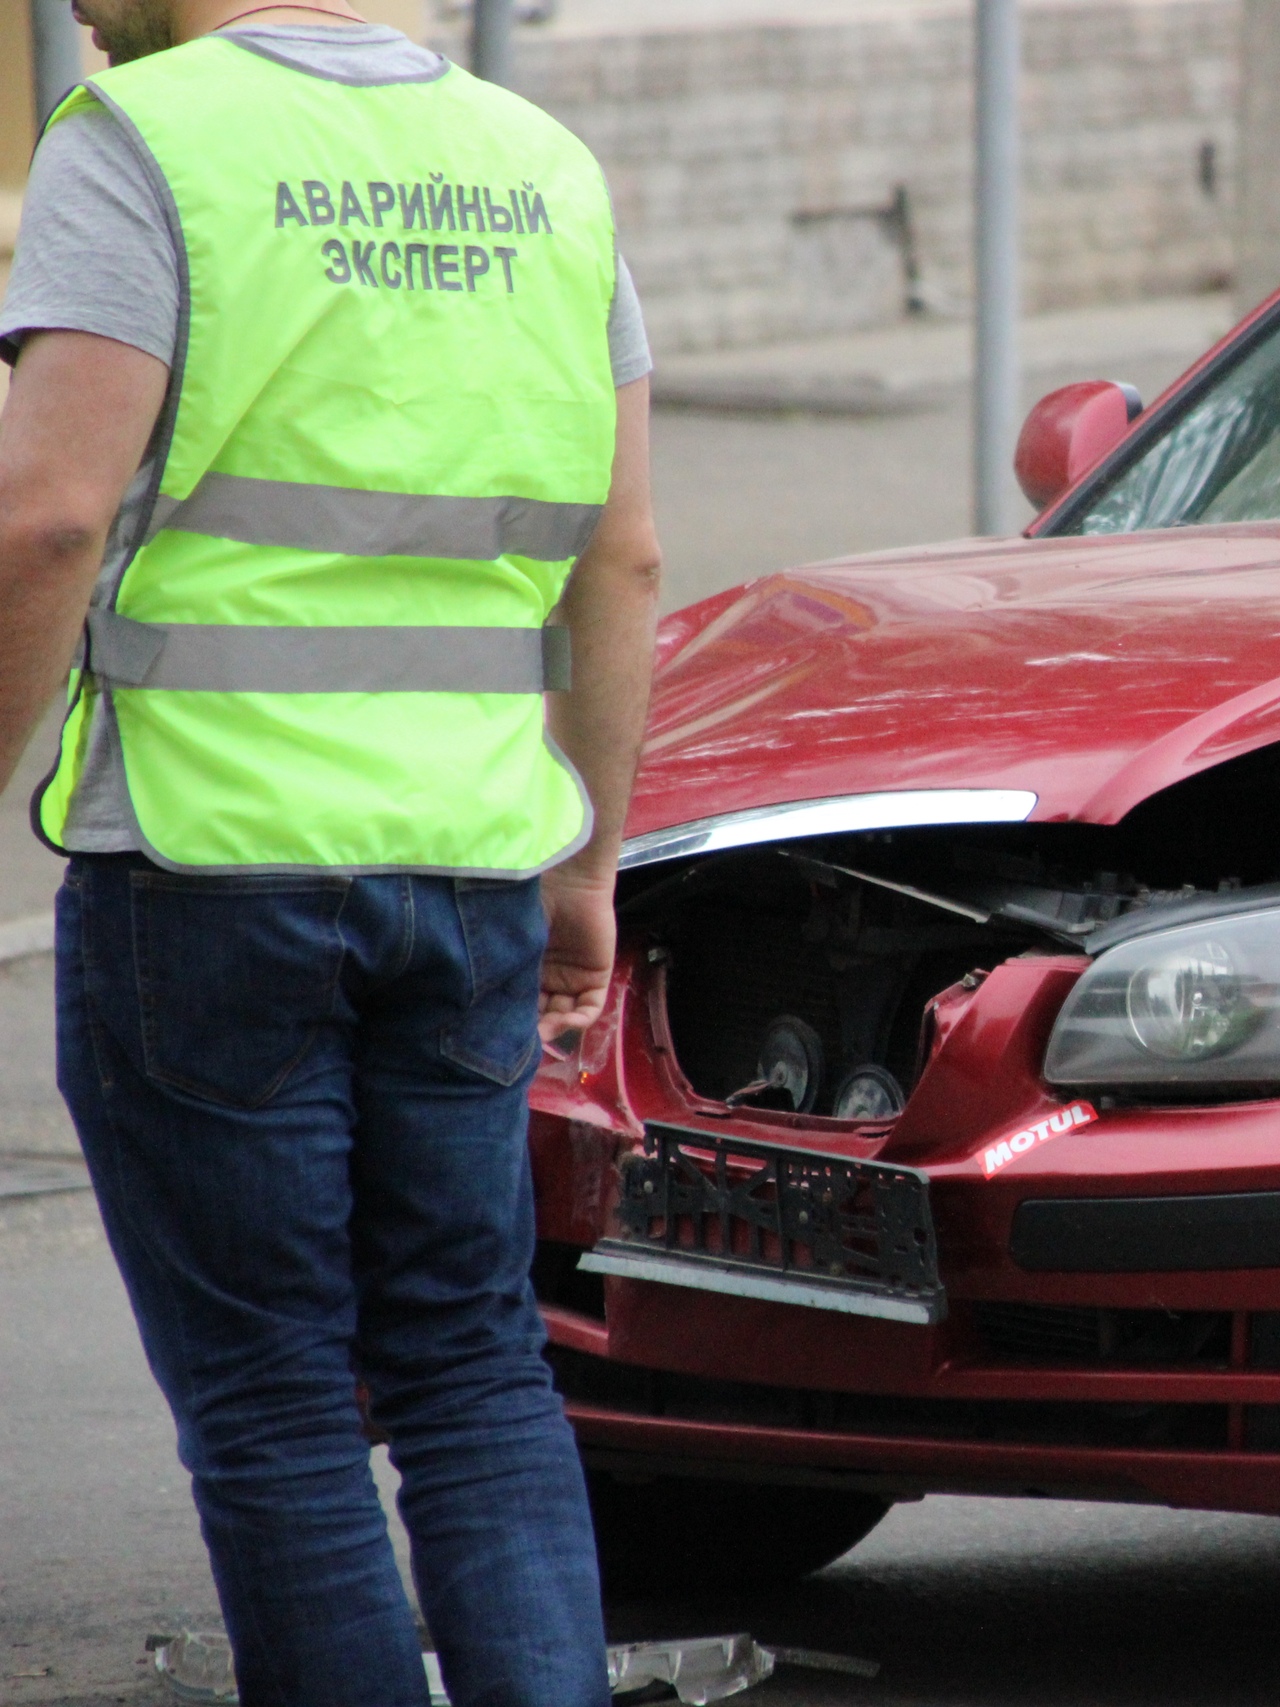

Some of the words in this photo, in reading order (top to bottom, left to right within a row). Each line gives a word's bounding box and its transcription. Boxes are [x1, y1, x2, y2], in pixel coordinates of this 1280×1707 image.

[275, 172, 553, 234] АВАРИЙНЫЙ
[321, 239, 517, 293] ЭКСПЕРТ
[984, 1105, 1091, 1174] MOTUL
